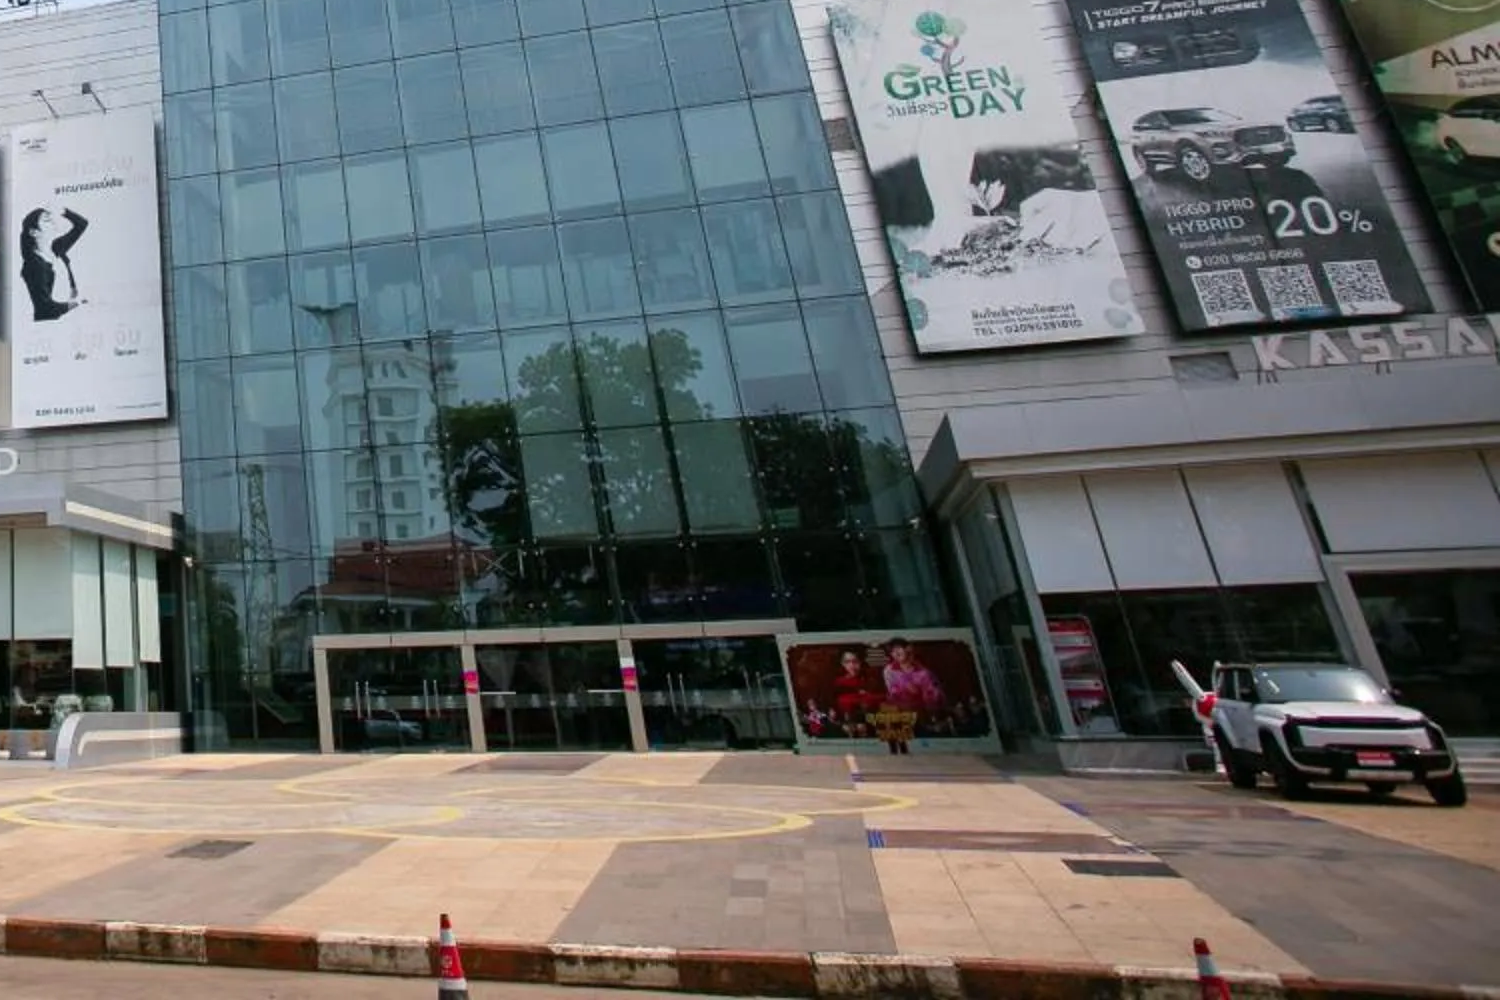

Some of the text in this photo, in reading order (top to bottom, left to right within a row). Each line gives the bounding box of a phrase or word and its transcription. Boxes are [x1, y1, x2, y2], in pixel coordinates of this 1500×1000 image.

[1097, 16, 1136, 29] START
[1210, 0, 1267, 15] JOURNEY
[1143, 0, 1160, 13] 7
[883, 64, 1011, 101] GREEN
[950, 87, 1026, 120] DAY
[1167, 215, 1246, 236] HYBRID
